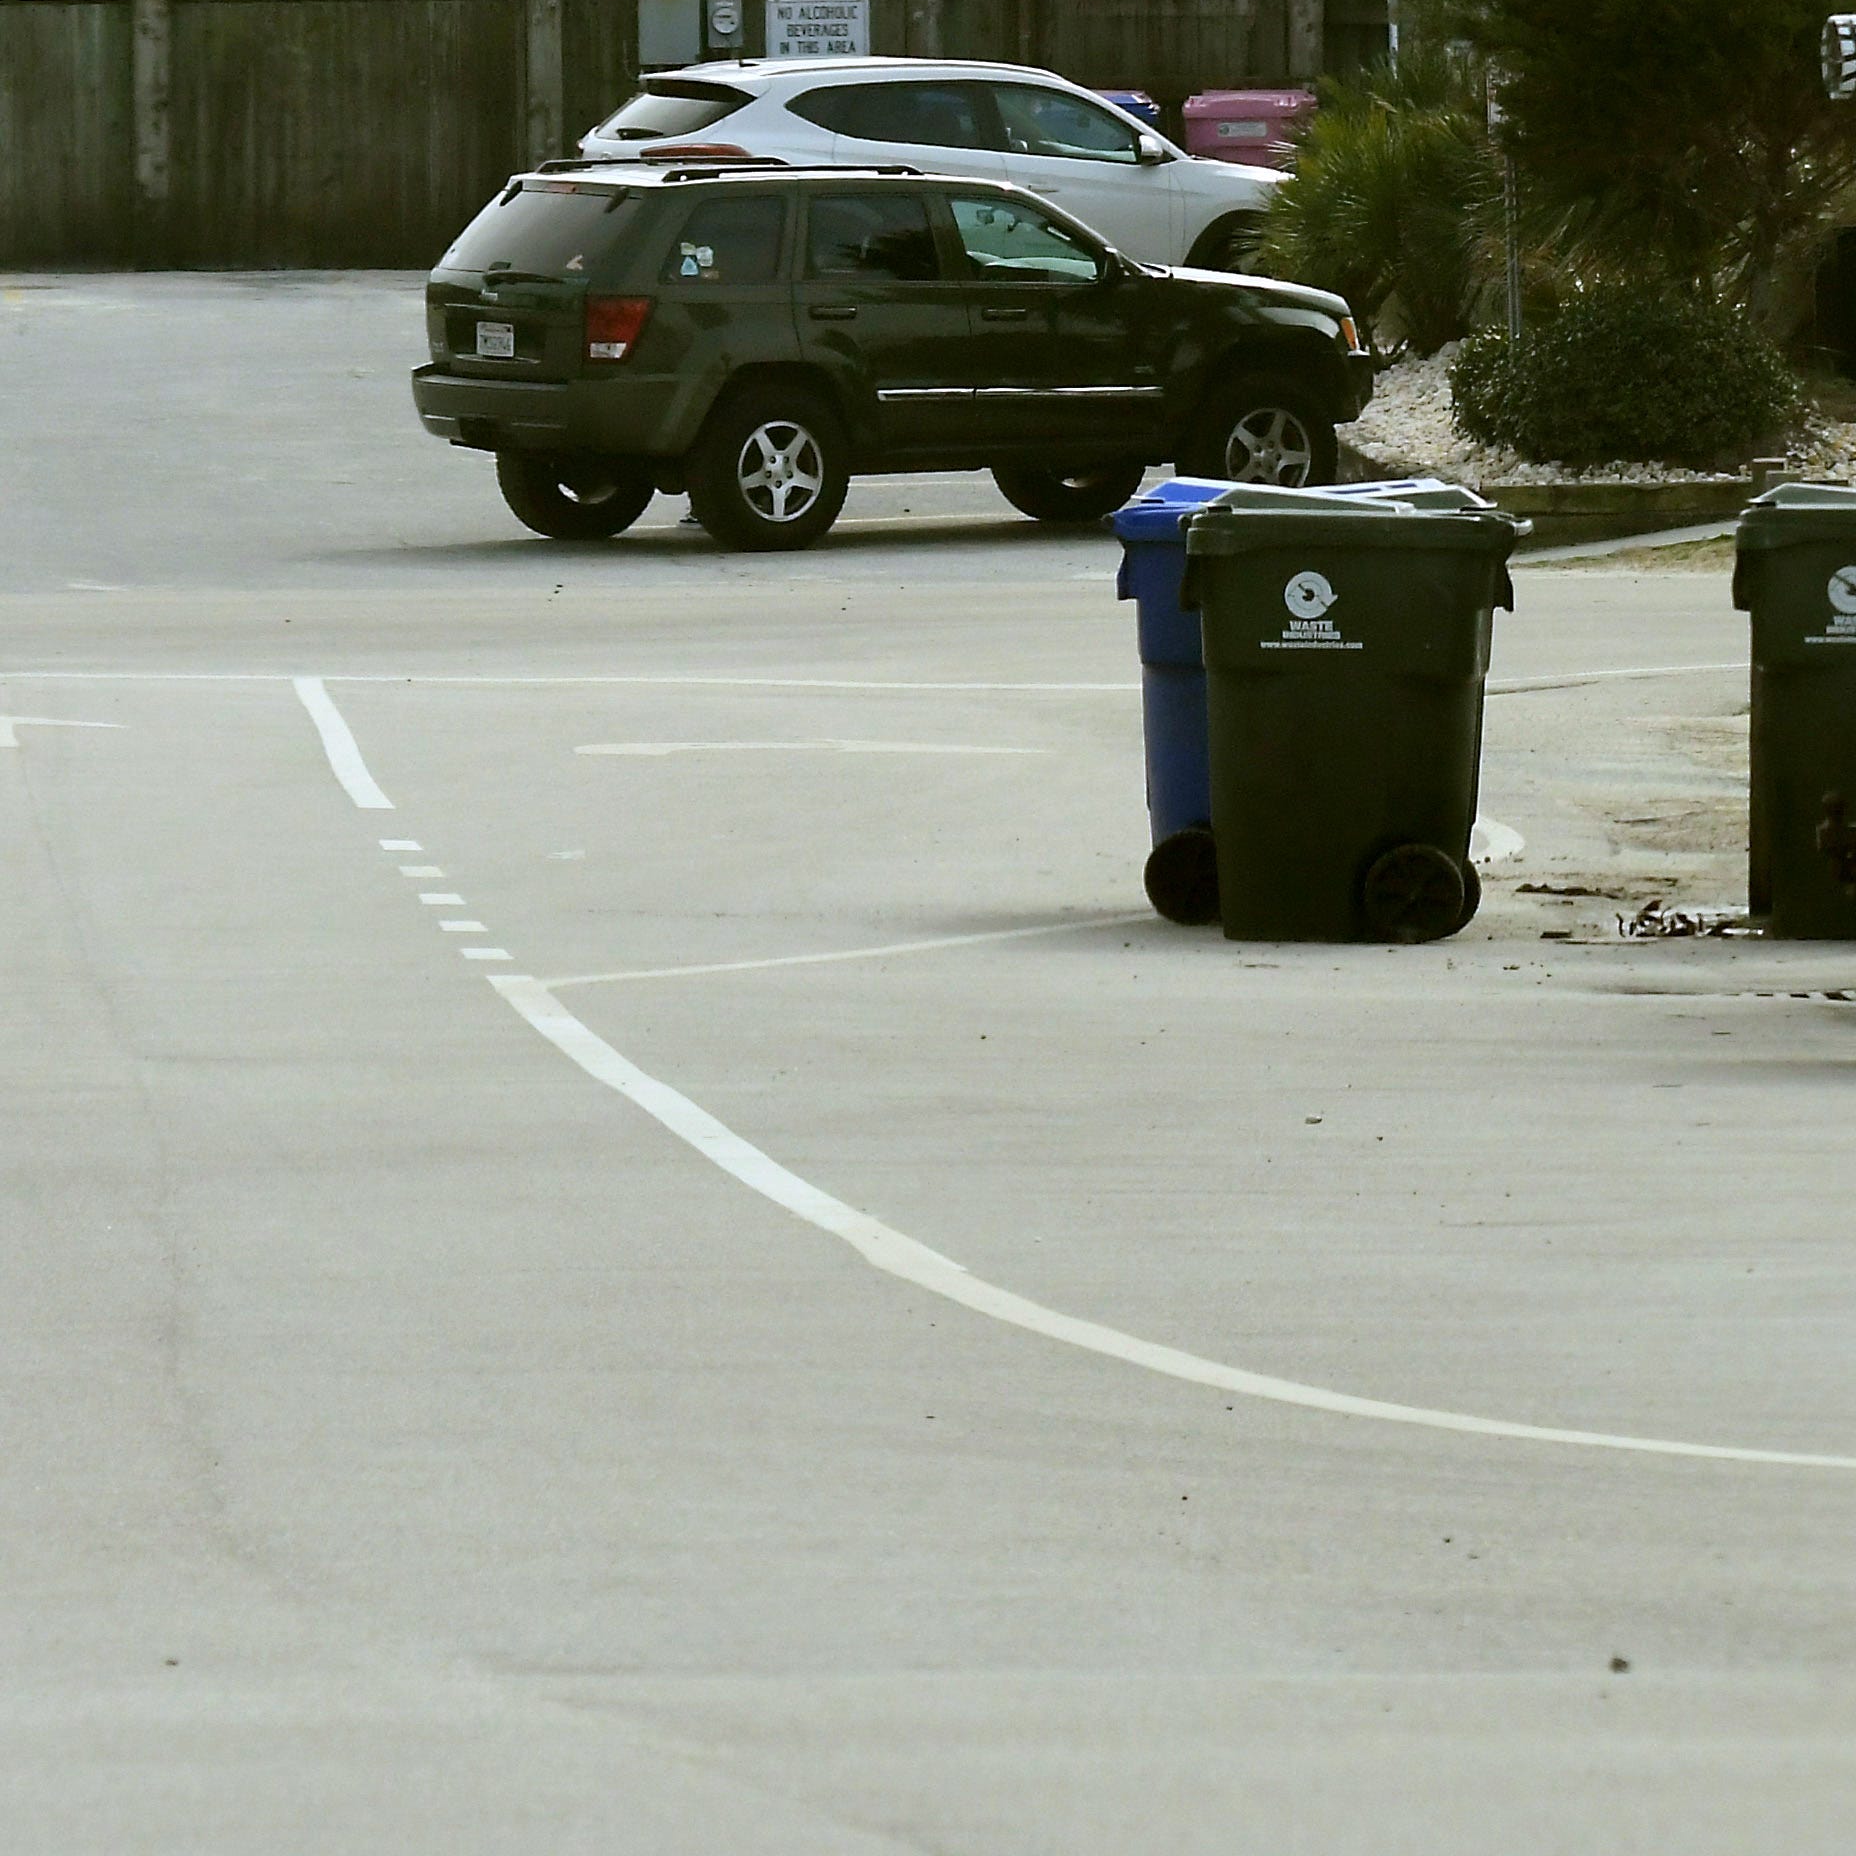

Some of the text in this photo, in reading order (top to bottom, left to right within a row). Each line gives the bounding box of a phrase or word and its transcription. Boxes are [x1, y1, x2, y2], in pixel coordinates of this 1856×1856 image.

[777, 5, 858, 20] NO ALCOHOLIC
[786, 23, 849, 37] BEVERAGES
[779, 40, 857, 54] IN THIS AREA
[1289, 620, 1333, 631] WASTE
